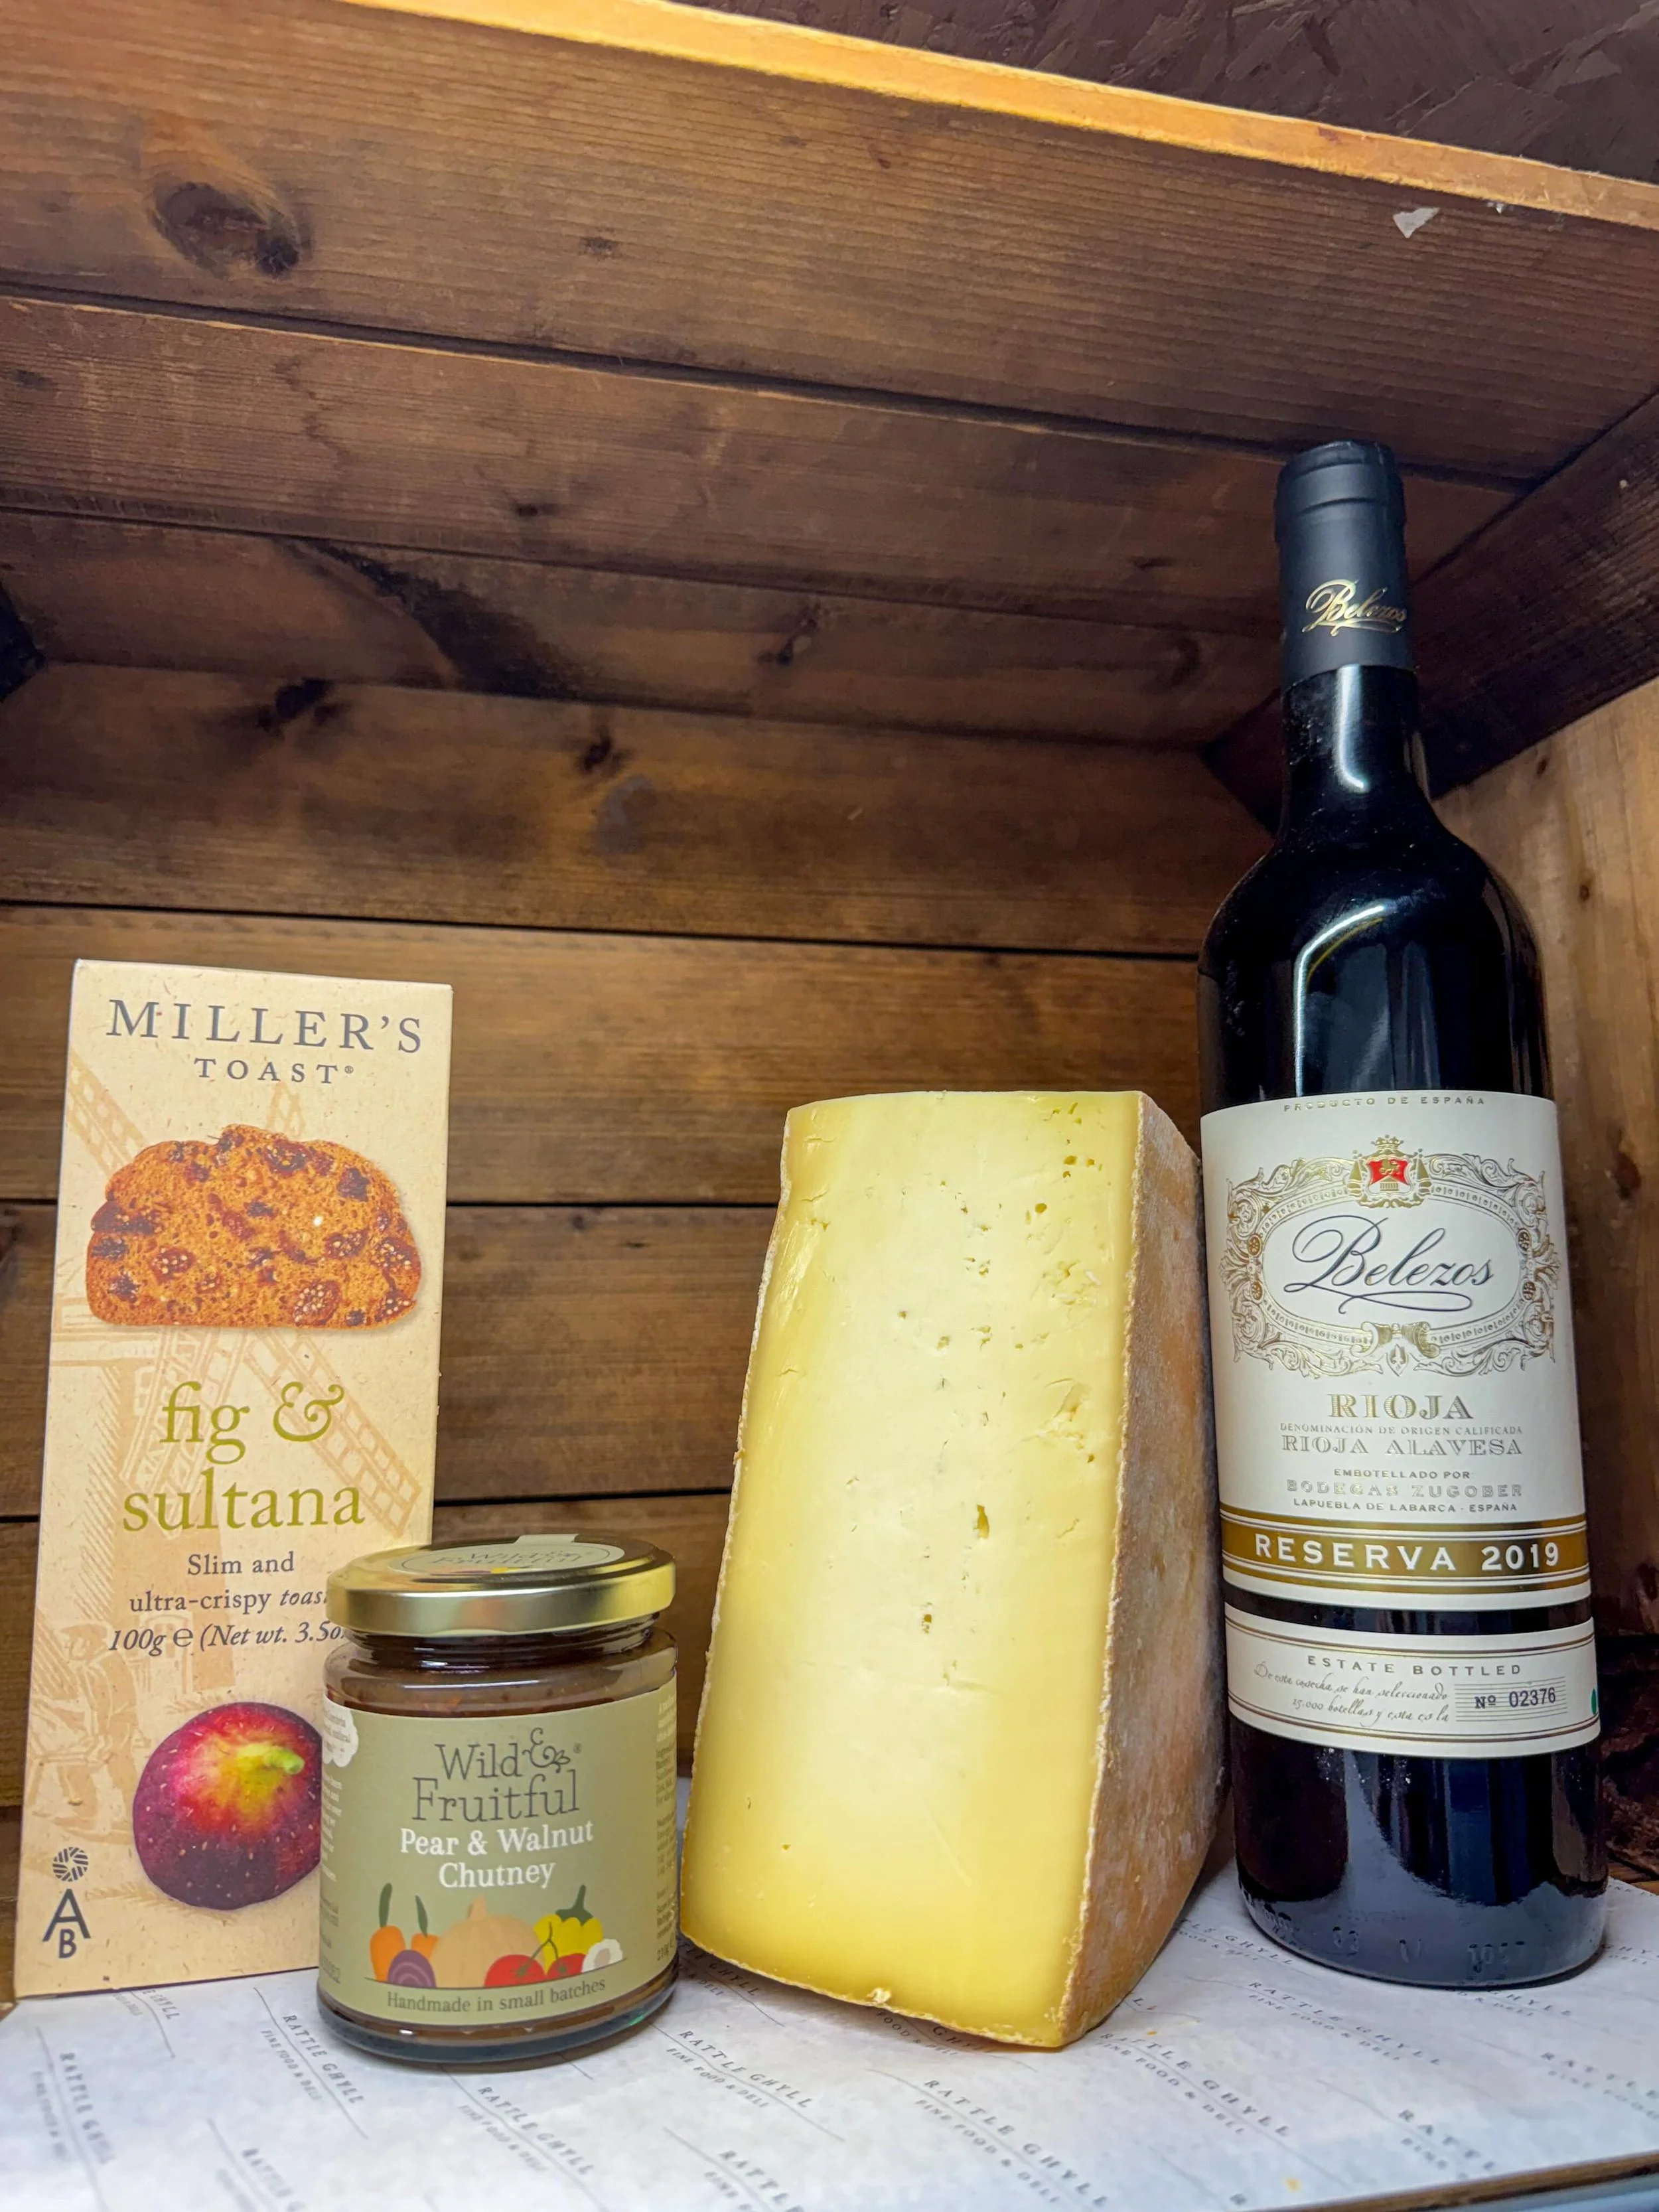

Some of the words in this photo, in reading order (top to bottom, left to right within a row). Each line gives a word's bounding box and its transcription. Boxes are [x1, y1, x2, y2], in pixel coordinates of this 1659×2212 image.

[1283, 1097, 1376, 1112] PRODUCTO
[1387, 1096, 1409, 1105] DE
[1420, 1096, 1485, 1106] ESPAÑA
[1283, 1215, 1494, 1314] Belezos
[159, 1381, 251, 1465] fig
[273, 1381, 345, 1442] &
[1327, 1393, 1475, 1420] RIOJA
[1279, 1422, 1373, 1435] DENOMINACIÓN
[1378, 1426, 1396, 1435] DE
[1400, 1426, 1451, 1436] ORIGEN
[1455, 1425, 1523, 1436] CALIFICADA
[1281, 1434, 1369, 1454] RIOJA
[1384, 1438, 1523, 1456] ALAVESA
[1286, 1479, 1399, 1497] BODEGAS
[1411, 1484, 1523, 1498] ZUGOBER
[1333, 1468, 1438, 1479] EMBOTELLADO
[122, 1467, 366, 1532] sultana
[1293, 1497, 1361, 1511] LAPUEBLA
[1366, 1503, 1384, 1511] DE
[1390, 1503, 1456, 1512] LABARCA
[1469, 1502, 1518, 1512] ESPAÑA
[187, 1554, 243, 1576] Slim
[252, 1550, 295, 1573] and
[1255, 1532, 1456, 1572] RESERVA
[1480, 1541, 1559, 1572] 2019
[129, 1589, 272, 1615] ultra-crispy
[108, 1629, 167, 1657] 100g
[200, 1623, 251, 1653] (Net
[255, 1629, 288, 1645] wt.
[294, 1620, 346, 1644] 3.5o
[1307, 1655, 1395, 1673] ESTATE
[1413, 1664, 1521, 1676] BOTTLED
[1508, 1686, 1557, 1708] 02376
[435, 1742, 522, 1781] Wild
[522, 1726, 571, 1774] &
[411, 1769, 580, 1823] Fruitful
[399, 1827, 459, 1856] Pear
[467, 1830, 488, 1856] &
[496, 1820, 595, 1852] Walnut
[438, 1862, 557, 1889] Chutney
[386, 1991, 471, 2013] Handmade
[476, 1990, 494, 2012] in
[498, 1991, 545, 2011] small
[549, 1977, 607, 2004] batches
[1248, 1982, 1344, 2022] RATTLE
[281, 2014, 328, 2057] RATTLE
[322, 2062, 365, 2104] GHYLL
[679, 2029, 747, 2073] RATTLE
[749, 2073, 813, 2109] GHYLL
[1135, 2057, 1181, 2087] FOOD
[666, 2047, 695, 2064] FINE
[693, 2065, 725, 2084] FOOD
[735, 2089, 770, 2108] DELI
[923, 2079, 1016, 2136] RATTLE
[1202, 2079, 1290, 2138] GHYLL
